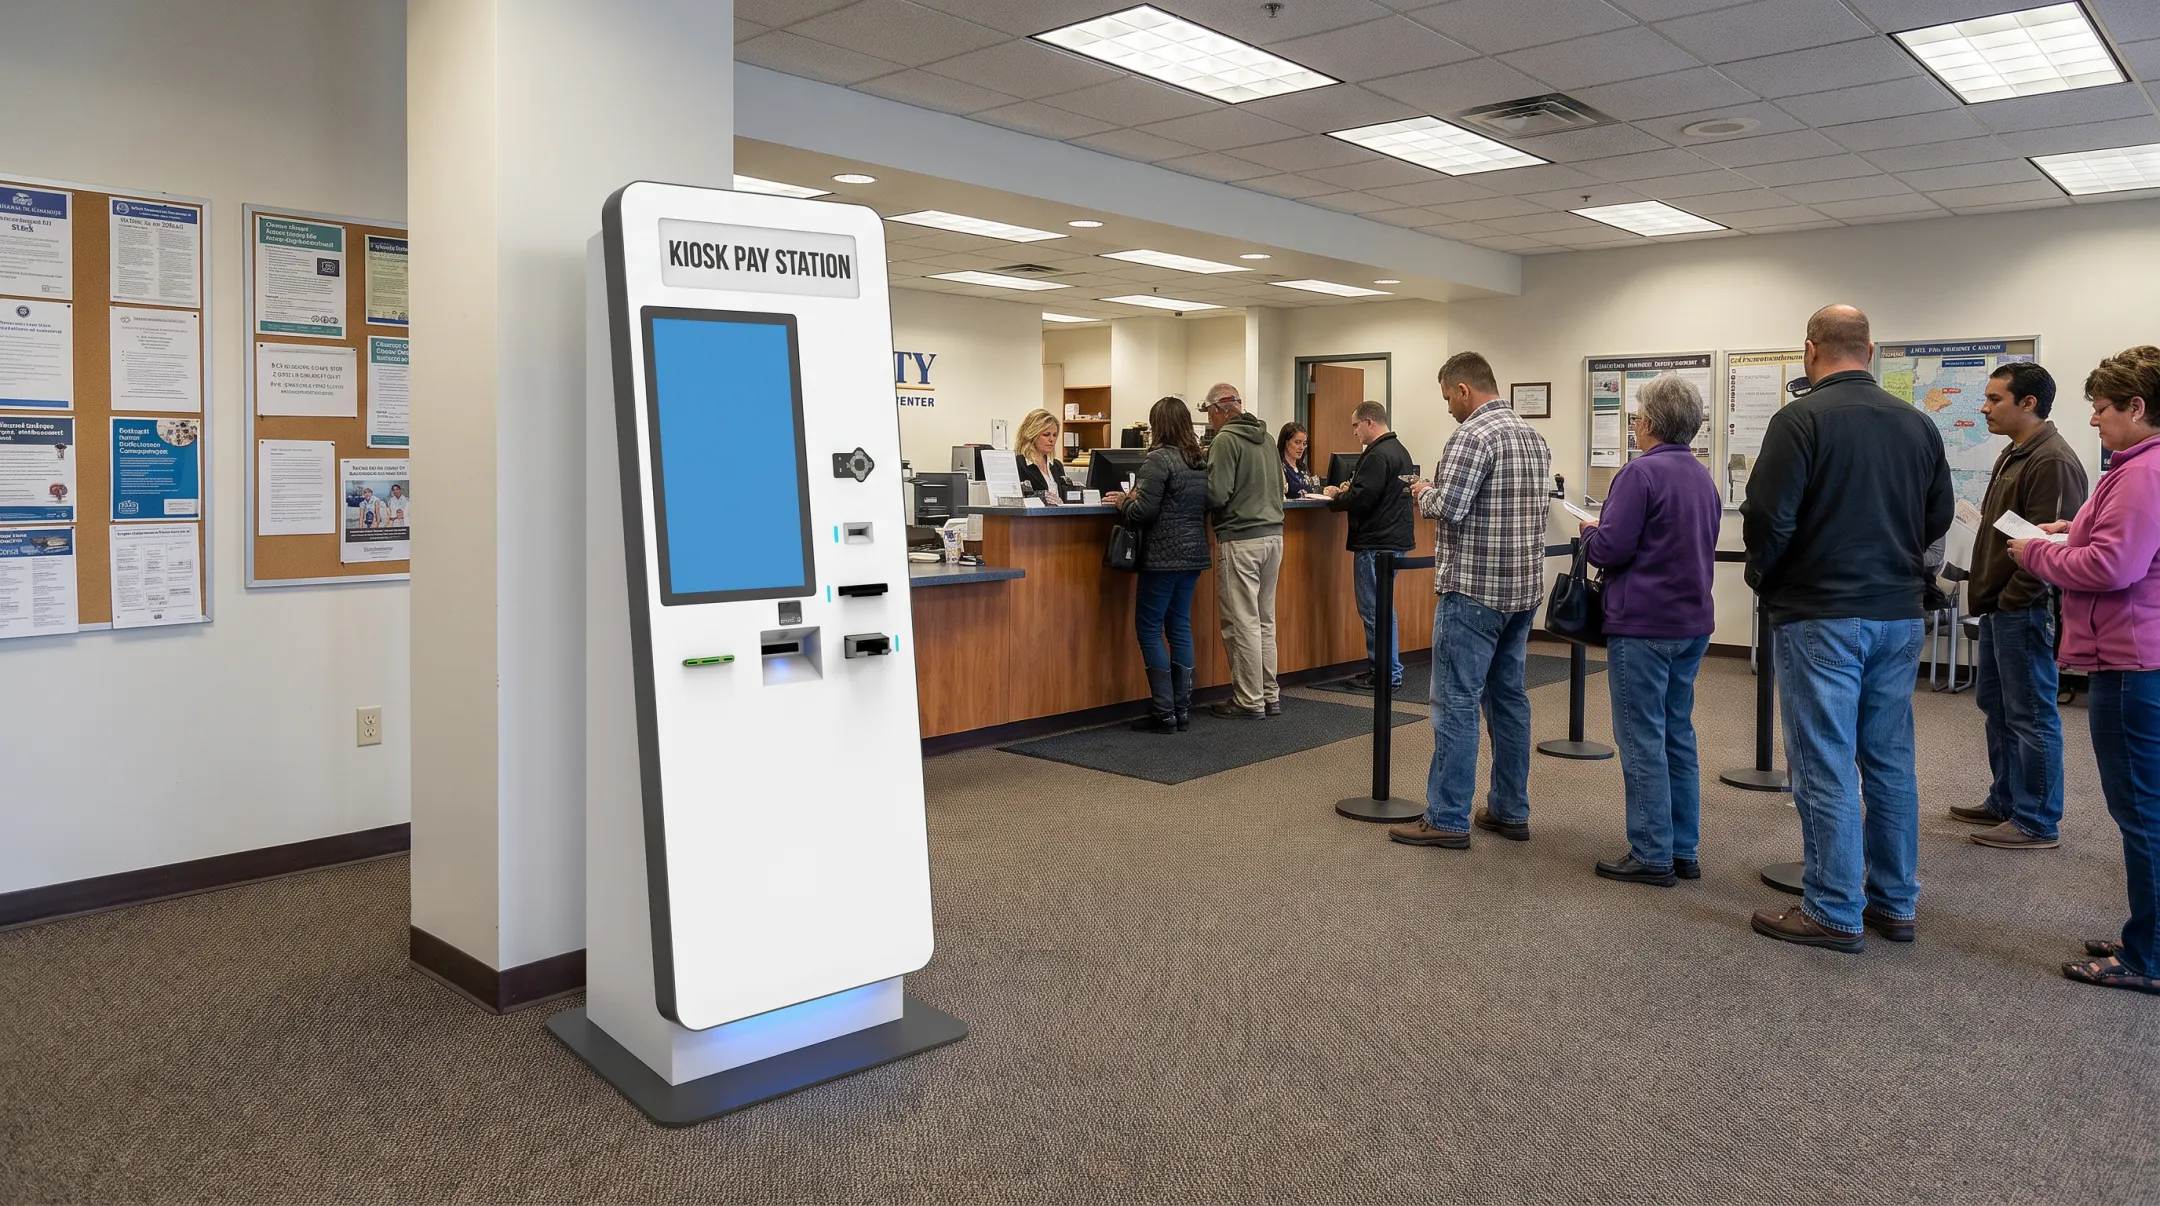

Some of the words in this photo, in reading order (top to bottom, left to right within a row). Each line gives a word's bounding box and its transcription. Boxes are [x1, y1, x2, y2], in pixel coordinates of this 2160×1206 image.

[669, 240, 729, 270] KIOSK
[734, 245, 769, 273] PAY
[775, 249, 851, 279] STATION
[894, 351, 937, 384] TY
[897, 396, 935, 407] ENTER
